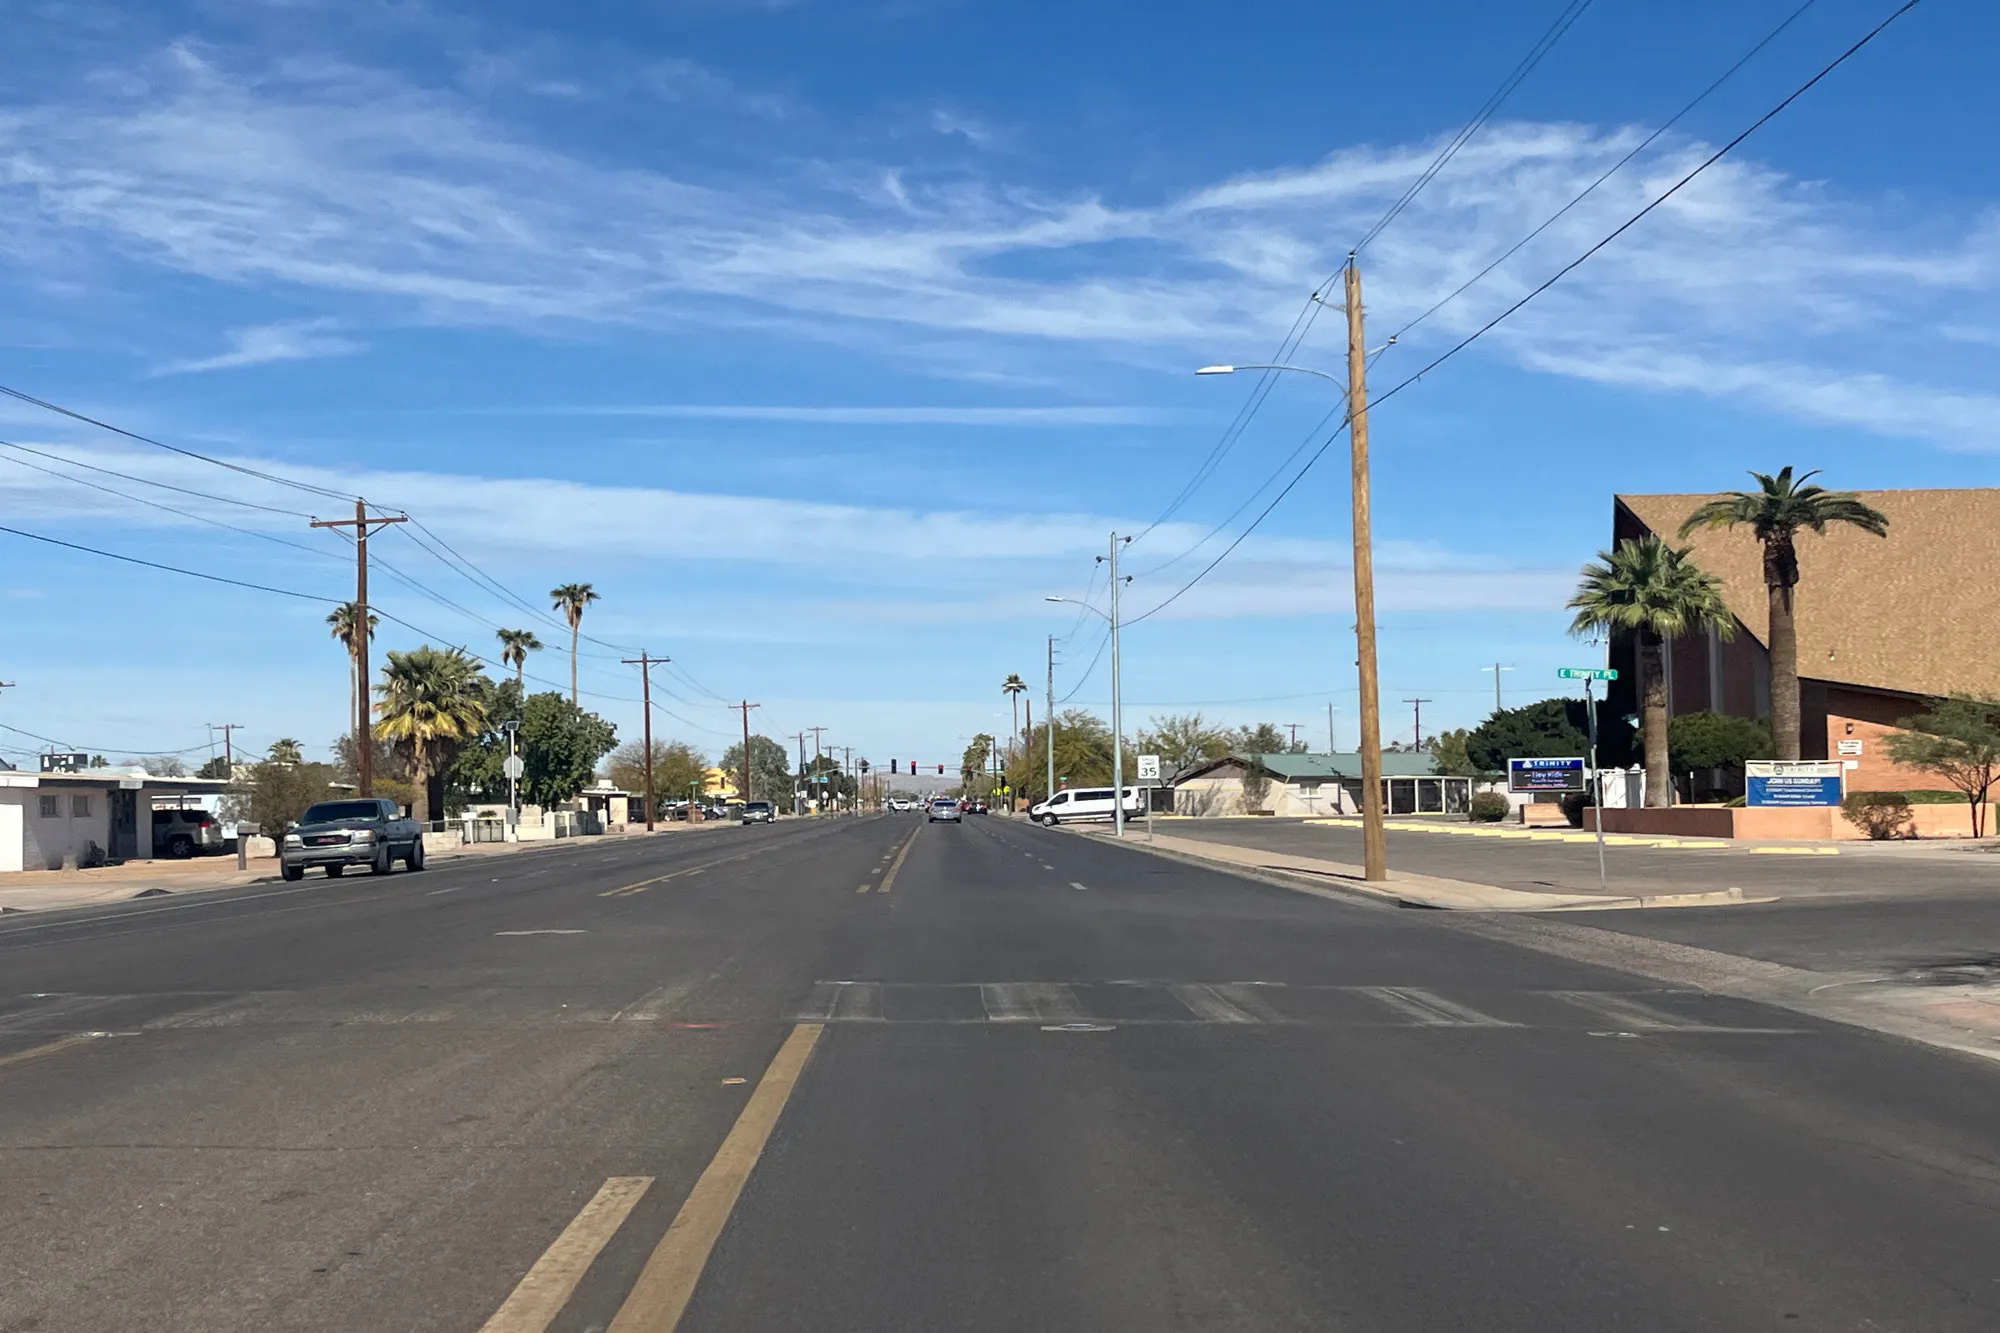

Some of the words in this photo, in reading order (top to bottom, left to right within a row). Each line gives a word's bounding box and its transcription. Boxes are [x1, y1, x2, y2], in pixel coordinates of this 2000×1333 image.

[1560, 670, 1566, 678] E
[1570, 670, 1601, 679] TRINITY
[1603, 671, 1614, 680] PL
[1141, 767, 1157, 777] 35
